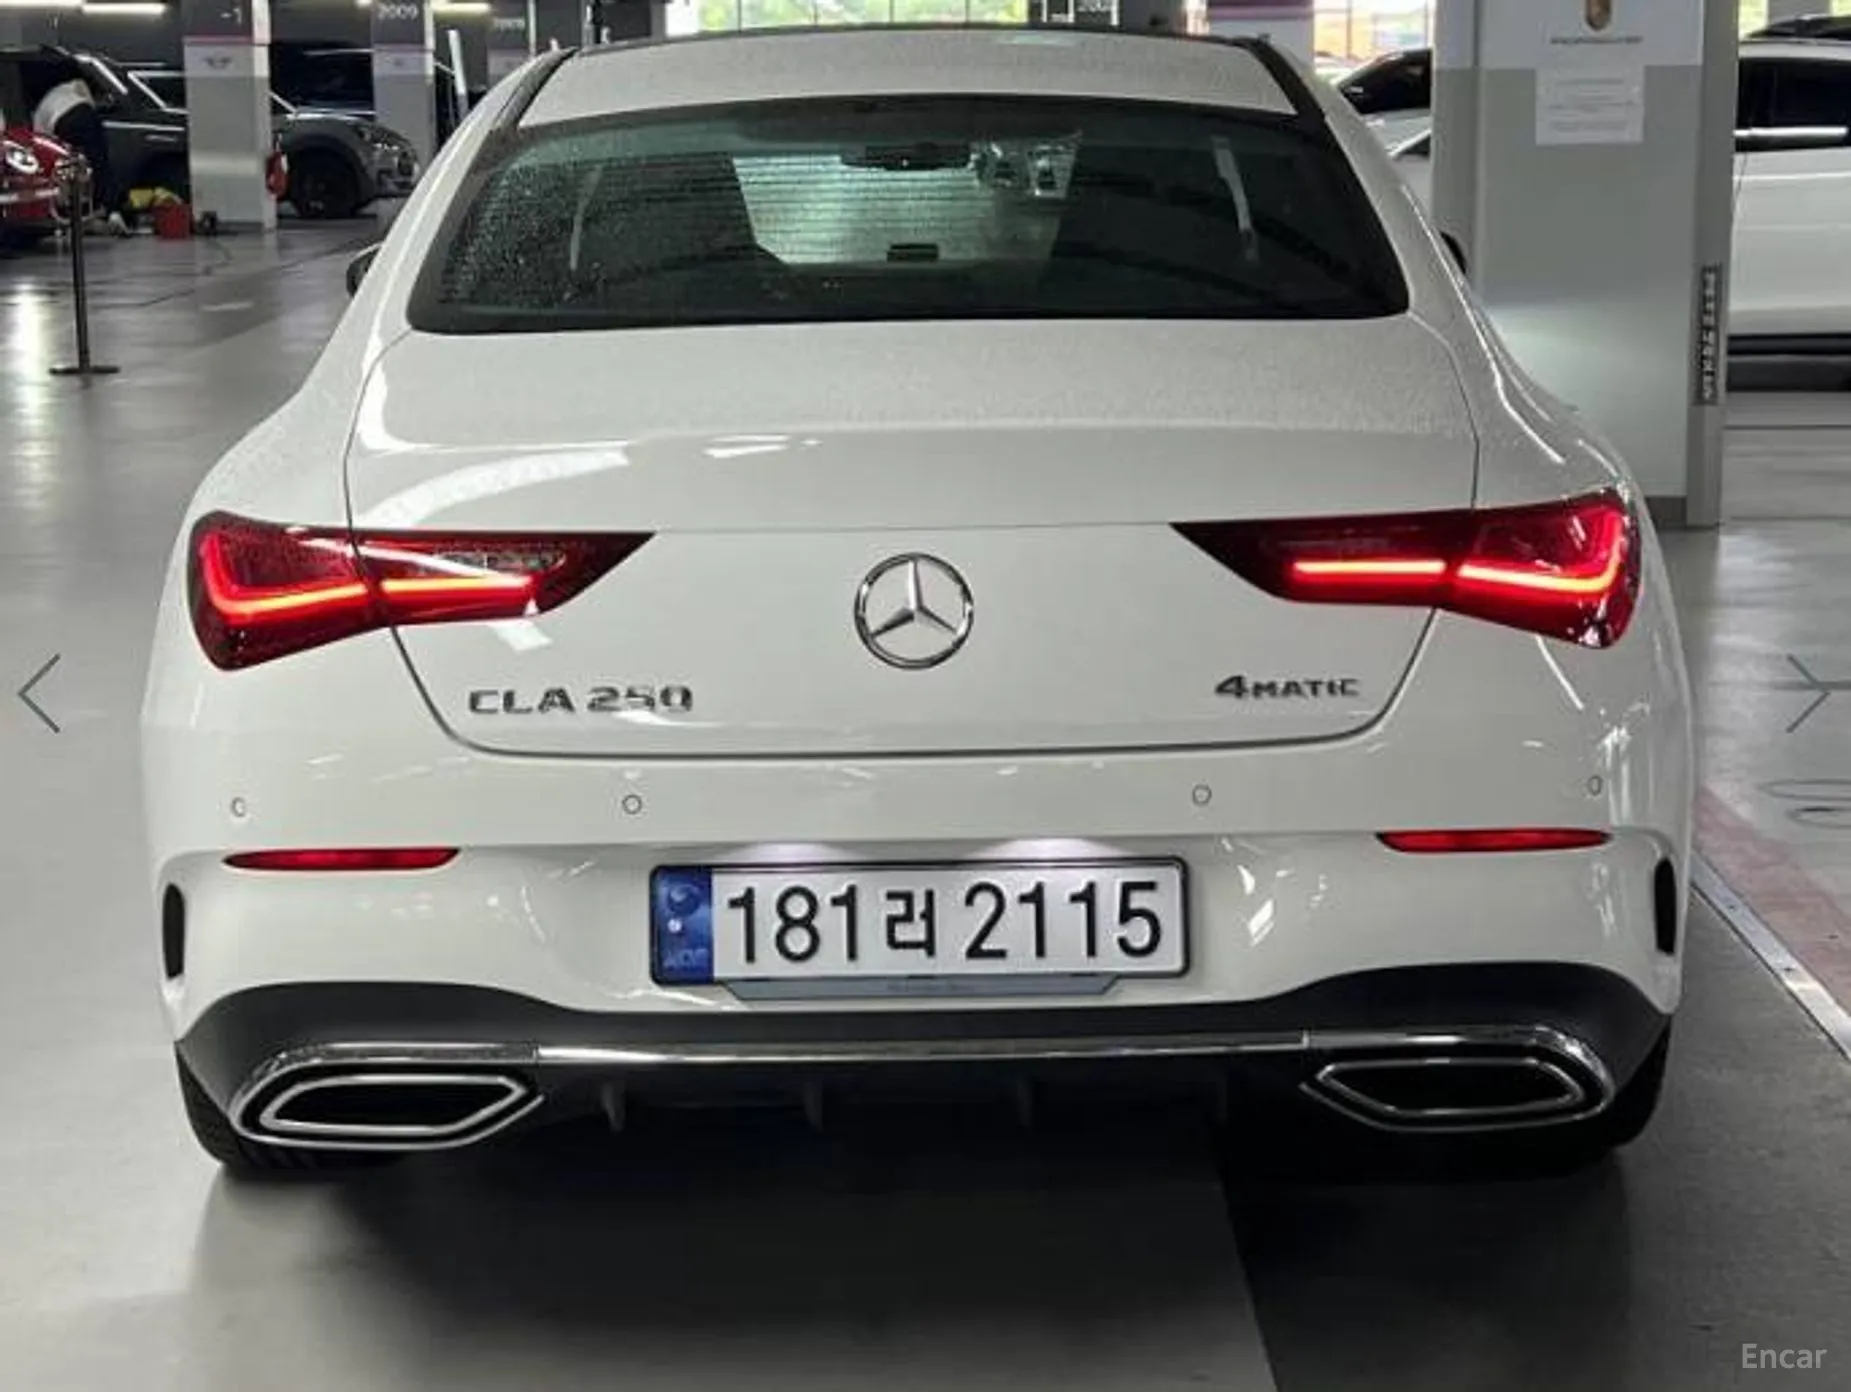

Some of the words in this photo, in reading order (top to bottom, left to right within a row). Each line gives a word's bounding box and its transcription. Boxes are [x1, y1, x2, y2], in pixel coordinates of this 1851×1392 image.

[468, 687, 576, 715] CLA
[587, 683, 693, 713] 250
[1214, 674, 1361, 701] 4MATIC
[964, 880, 1162, 959] 2115
